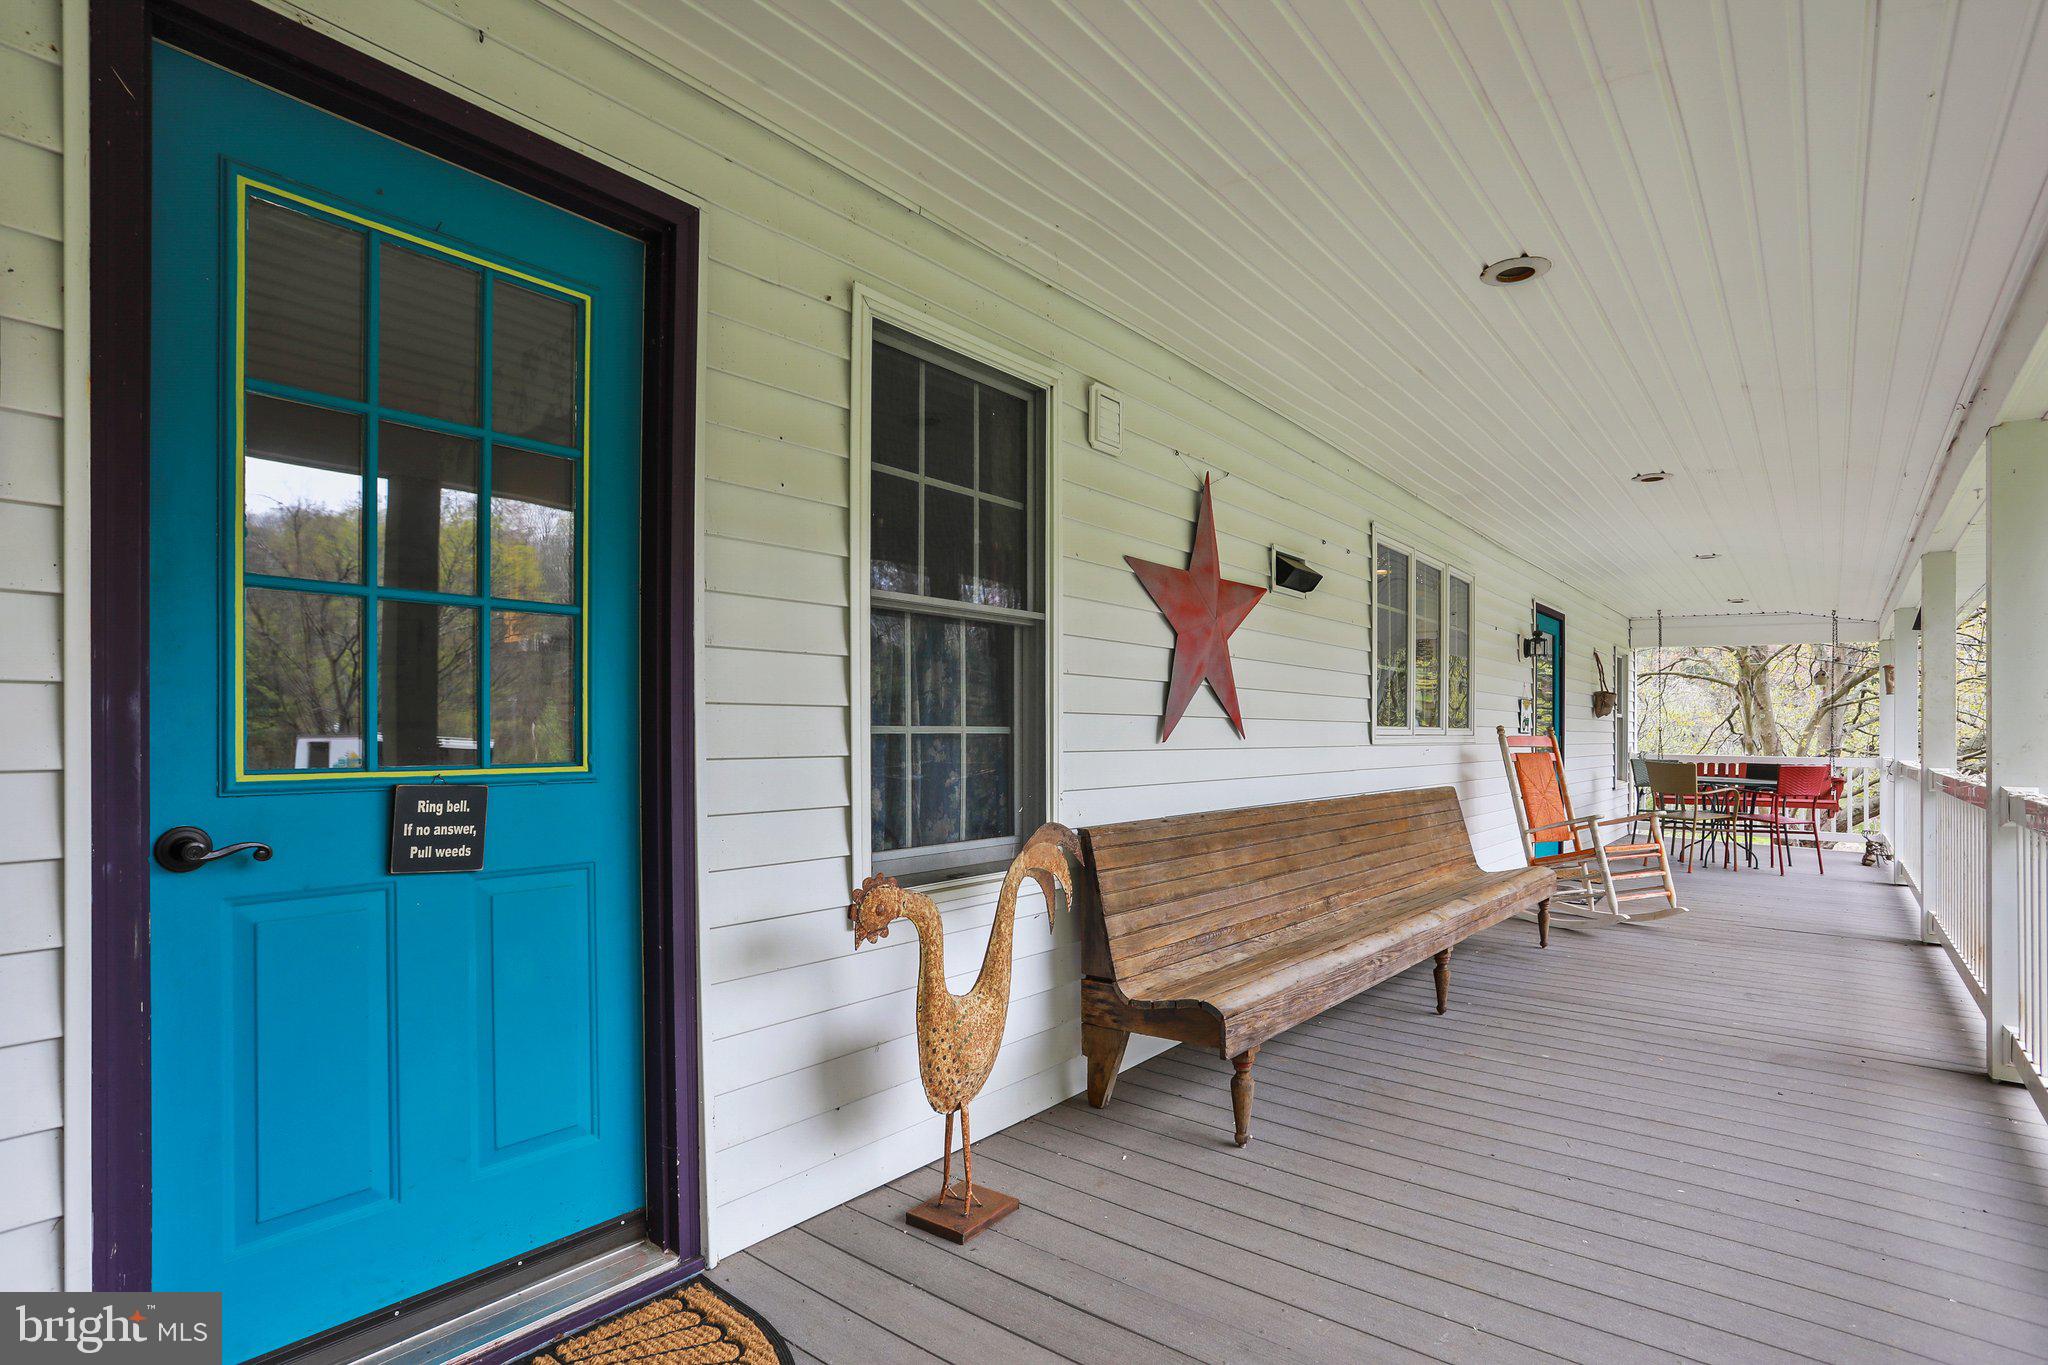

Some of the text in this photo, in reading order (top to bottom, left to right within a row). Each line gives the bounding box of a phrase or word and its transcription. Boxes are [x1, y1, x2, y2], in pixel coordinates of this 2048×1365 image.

[417, 800, 470, 816] Ring bell.
[403, 823, 477, 837] If no answer,
[409, 845, 472, 859] Pull weeds
